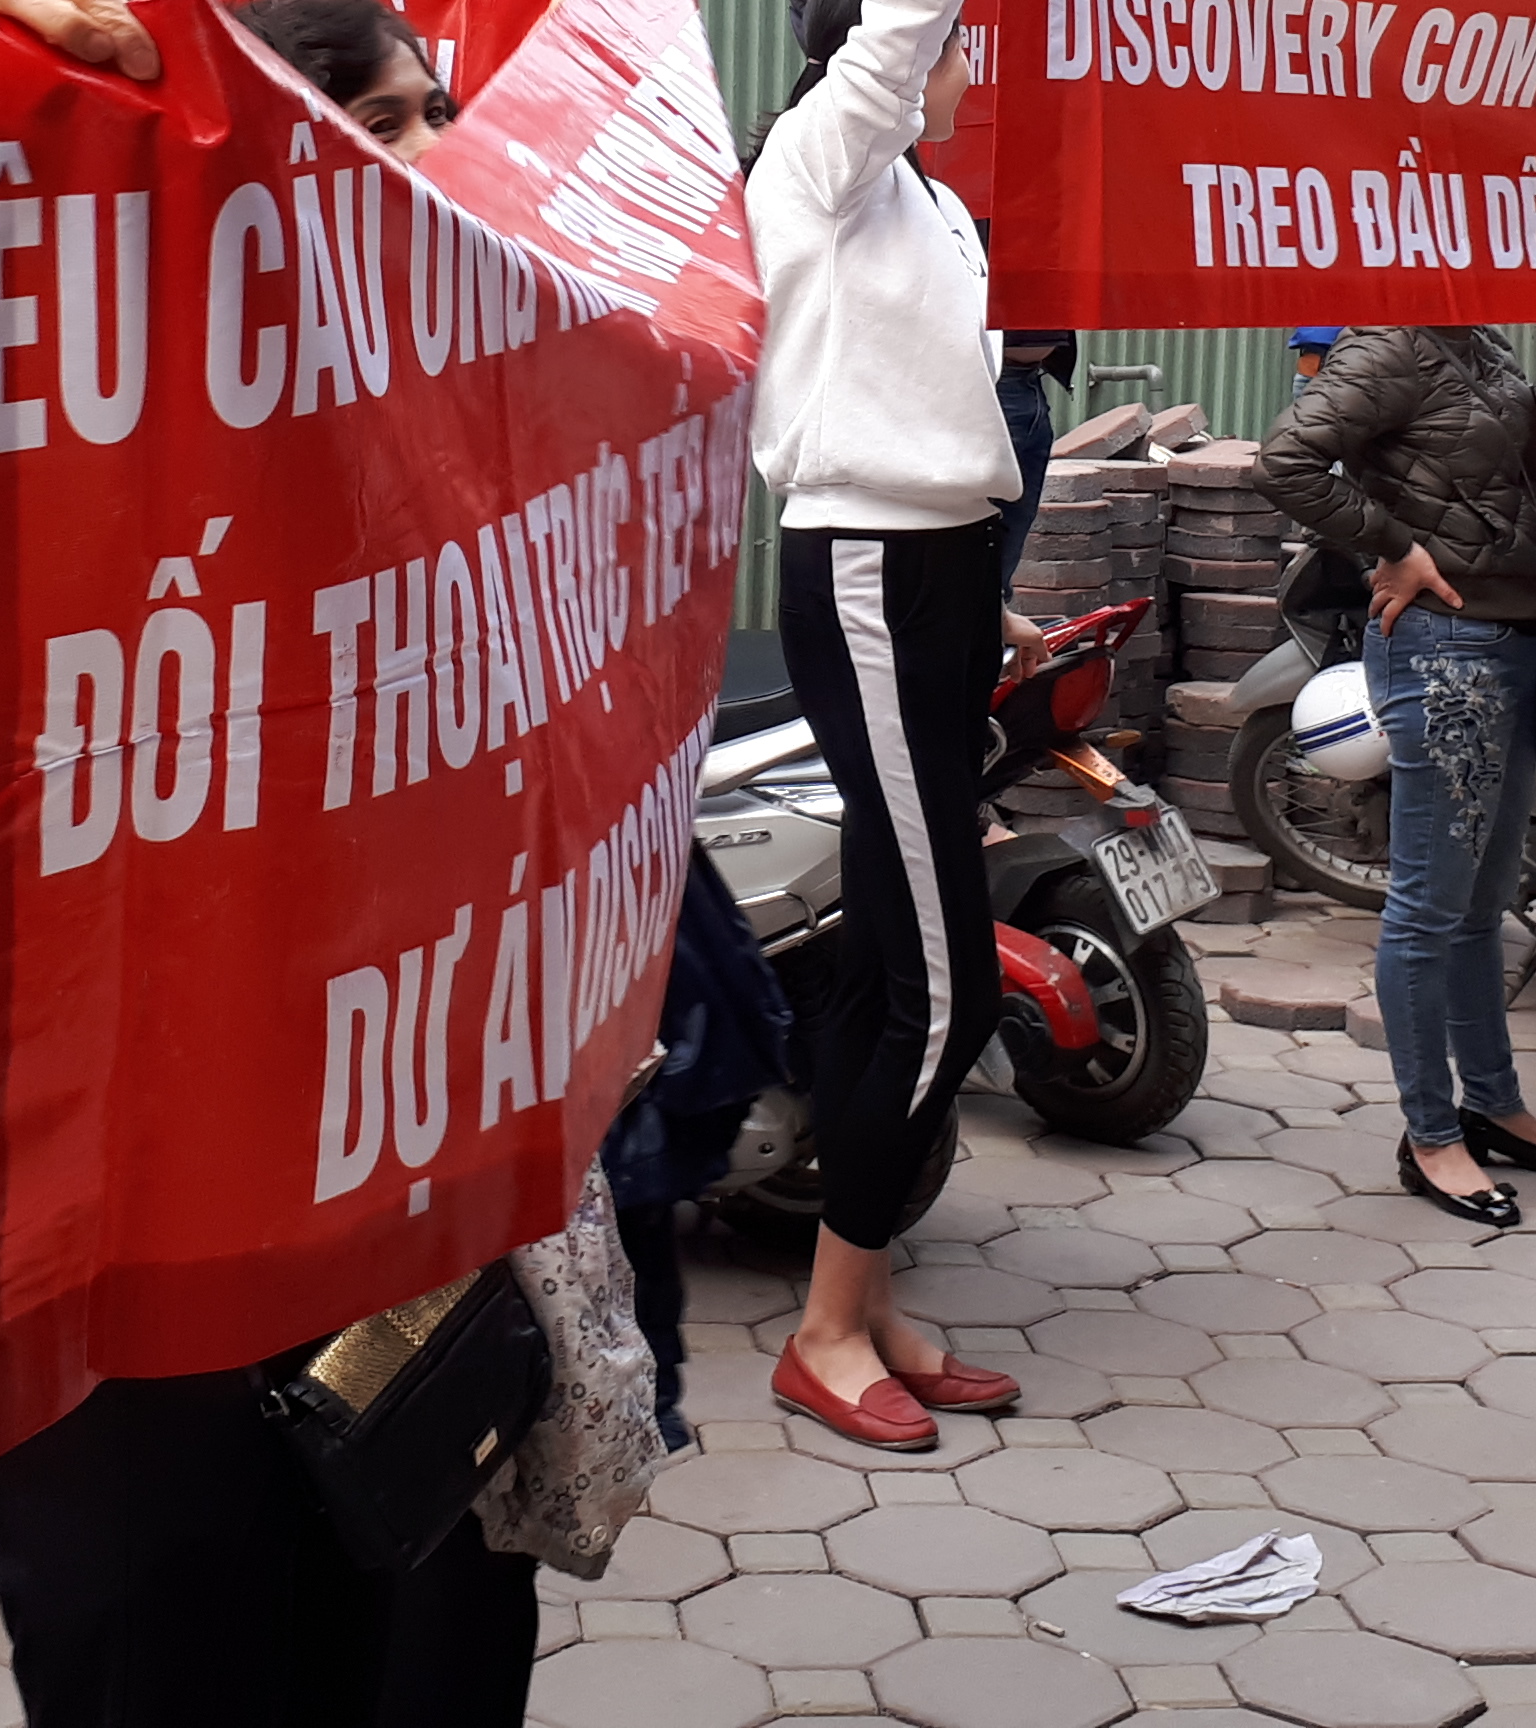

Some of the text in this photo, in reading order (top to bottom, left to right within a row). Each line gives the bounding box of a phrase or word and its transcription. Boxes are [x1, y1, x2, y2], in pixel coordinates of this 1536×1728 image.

[205, 87, 390, 429] CẦU
[1181, 163, 1338, 269] TREO
[1351, 136, 1472, 271] ĐẦU
[33, 516, 267, 876] ĐỐI
[313, 510, 532, 797] THOẠI
[525, 440, 630, 713] TRỰC
[313, 904, 471, 1216] DỰ
